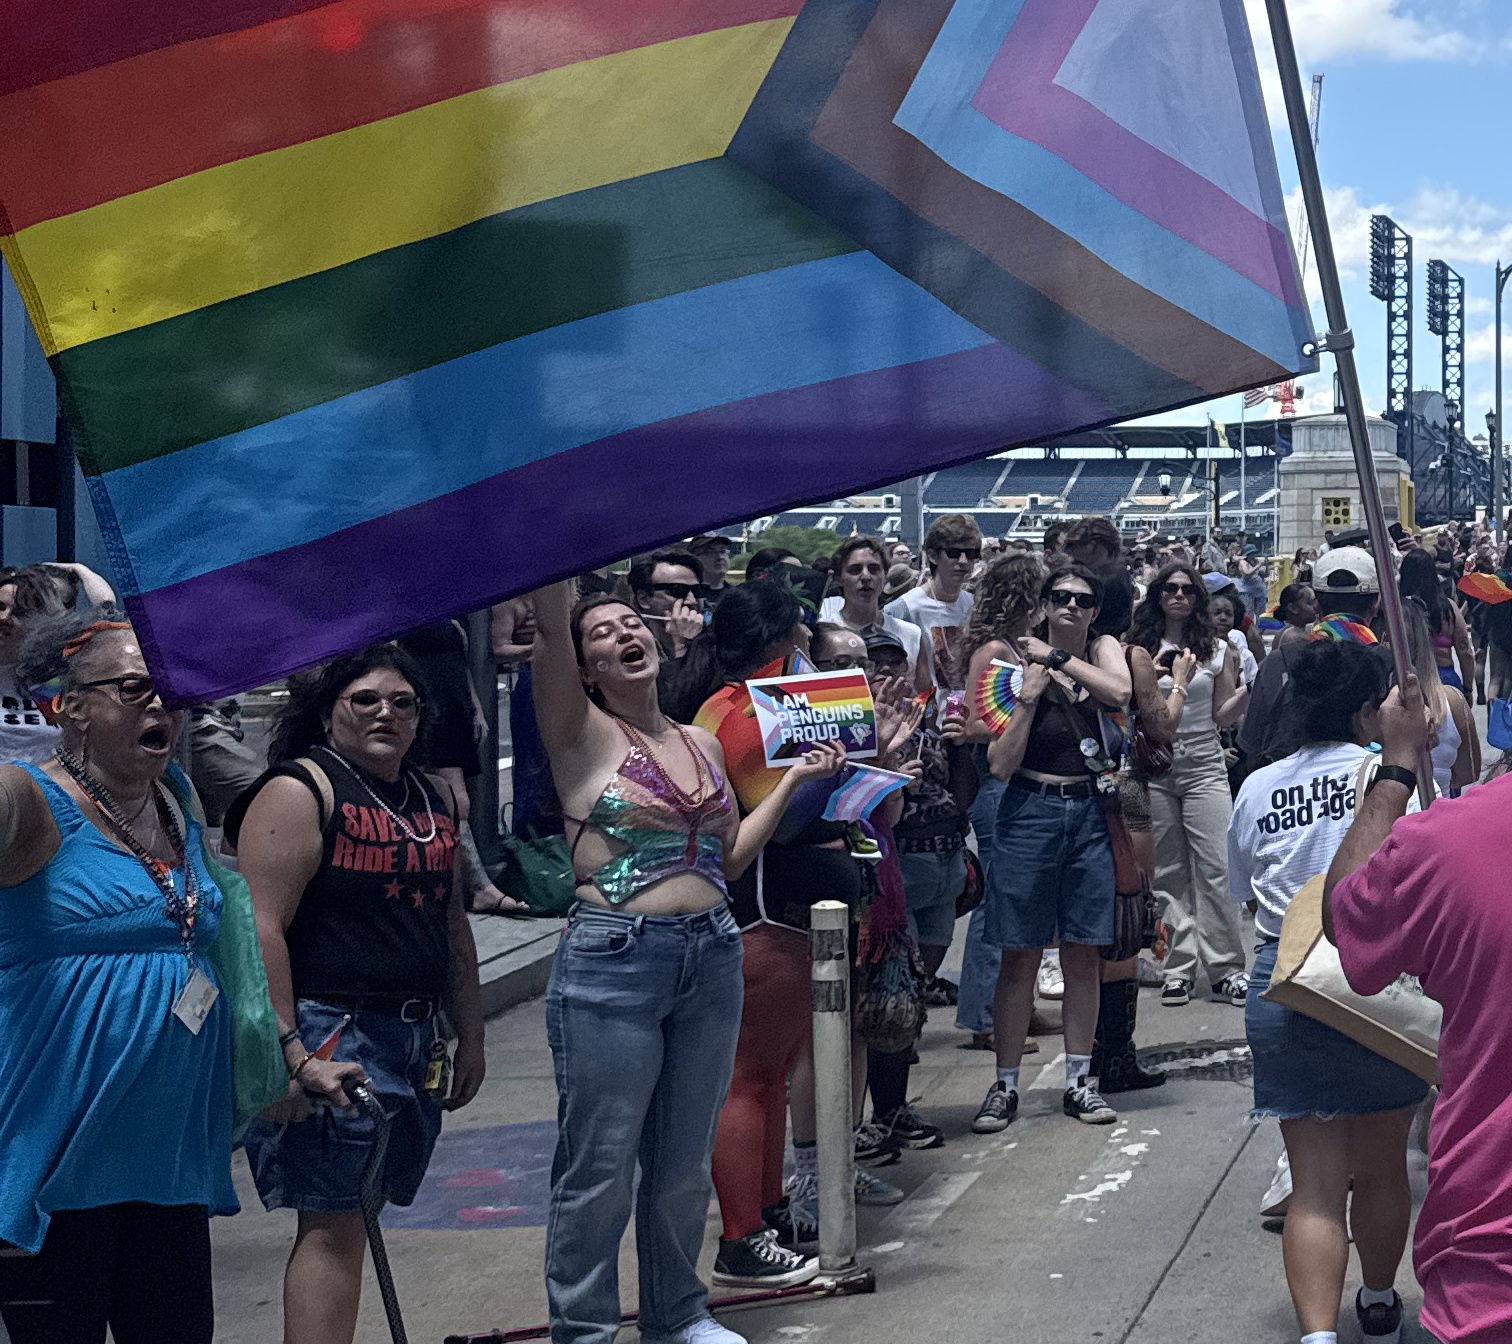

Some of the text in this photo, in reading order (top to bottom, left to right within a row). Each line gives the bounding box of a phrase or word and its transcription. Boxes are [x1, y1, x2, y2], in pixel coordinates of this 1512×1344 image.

[770, 692, 812, 711] I AM
[776, 703, 865, 727] PENGUINS
[780, 723, 840, 745] PROUD
[1271, 773, 1349, 810] on the
[341, 802, 402, 843] SAVE
[1256, 788, 1356, 835] road aga
[331, 833, 399, 873] RIDE
[405, 842, 421, 873] A
